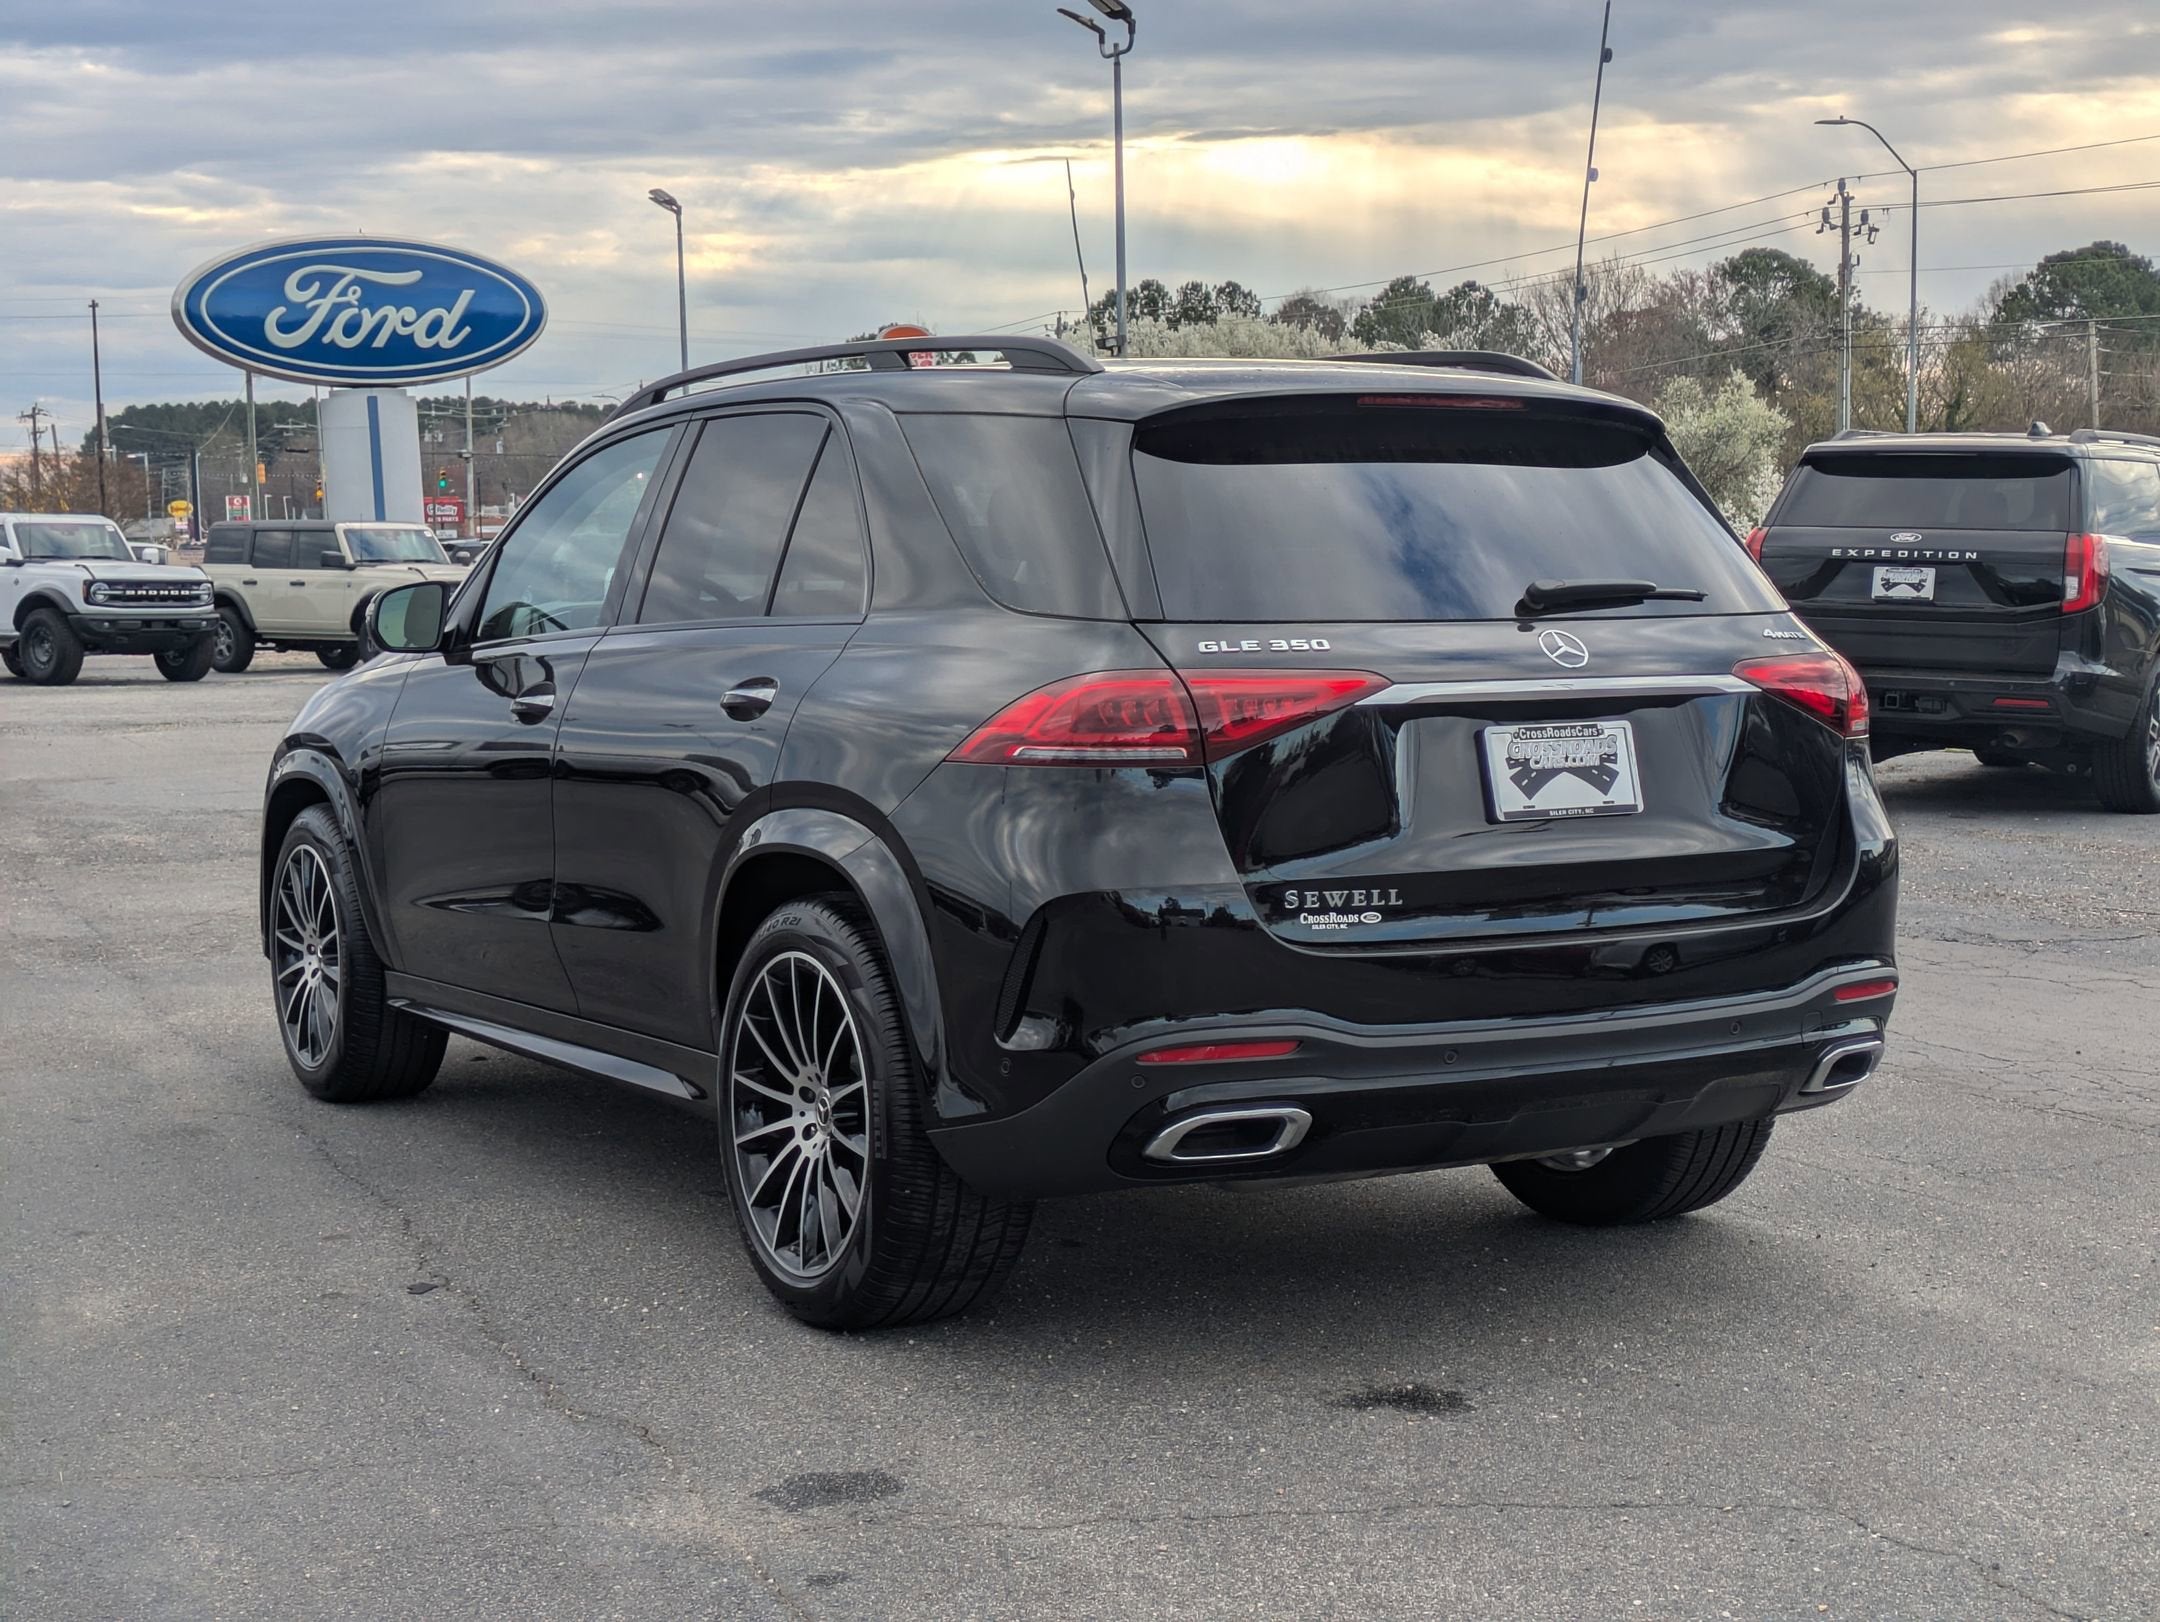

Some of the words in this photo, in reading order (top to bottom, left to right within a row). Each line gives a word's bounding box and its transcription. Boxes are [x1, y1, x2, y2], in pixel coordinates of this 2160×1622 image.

[263, 264, 476, 349] Ford
[1832, 548, 1977, 560] EXPEDITION
[1198, 640, 1262, 653] GLE
[1268, 638, 1331, 652] 350
[1519, 726, 1599, 740] CrossRoadsCars
[1284, 889, 1403, 909] SEWELL
